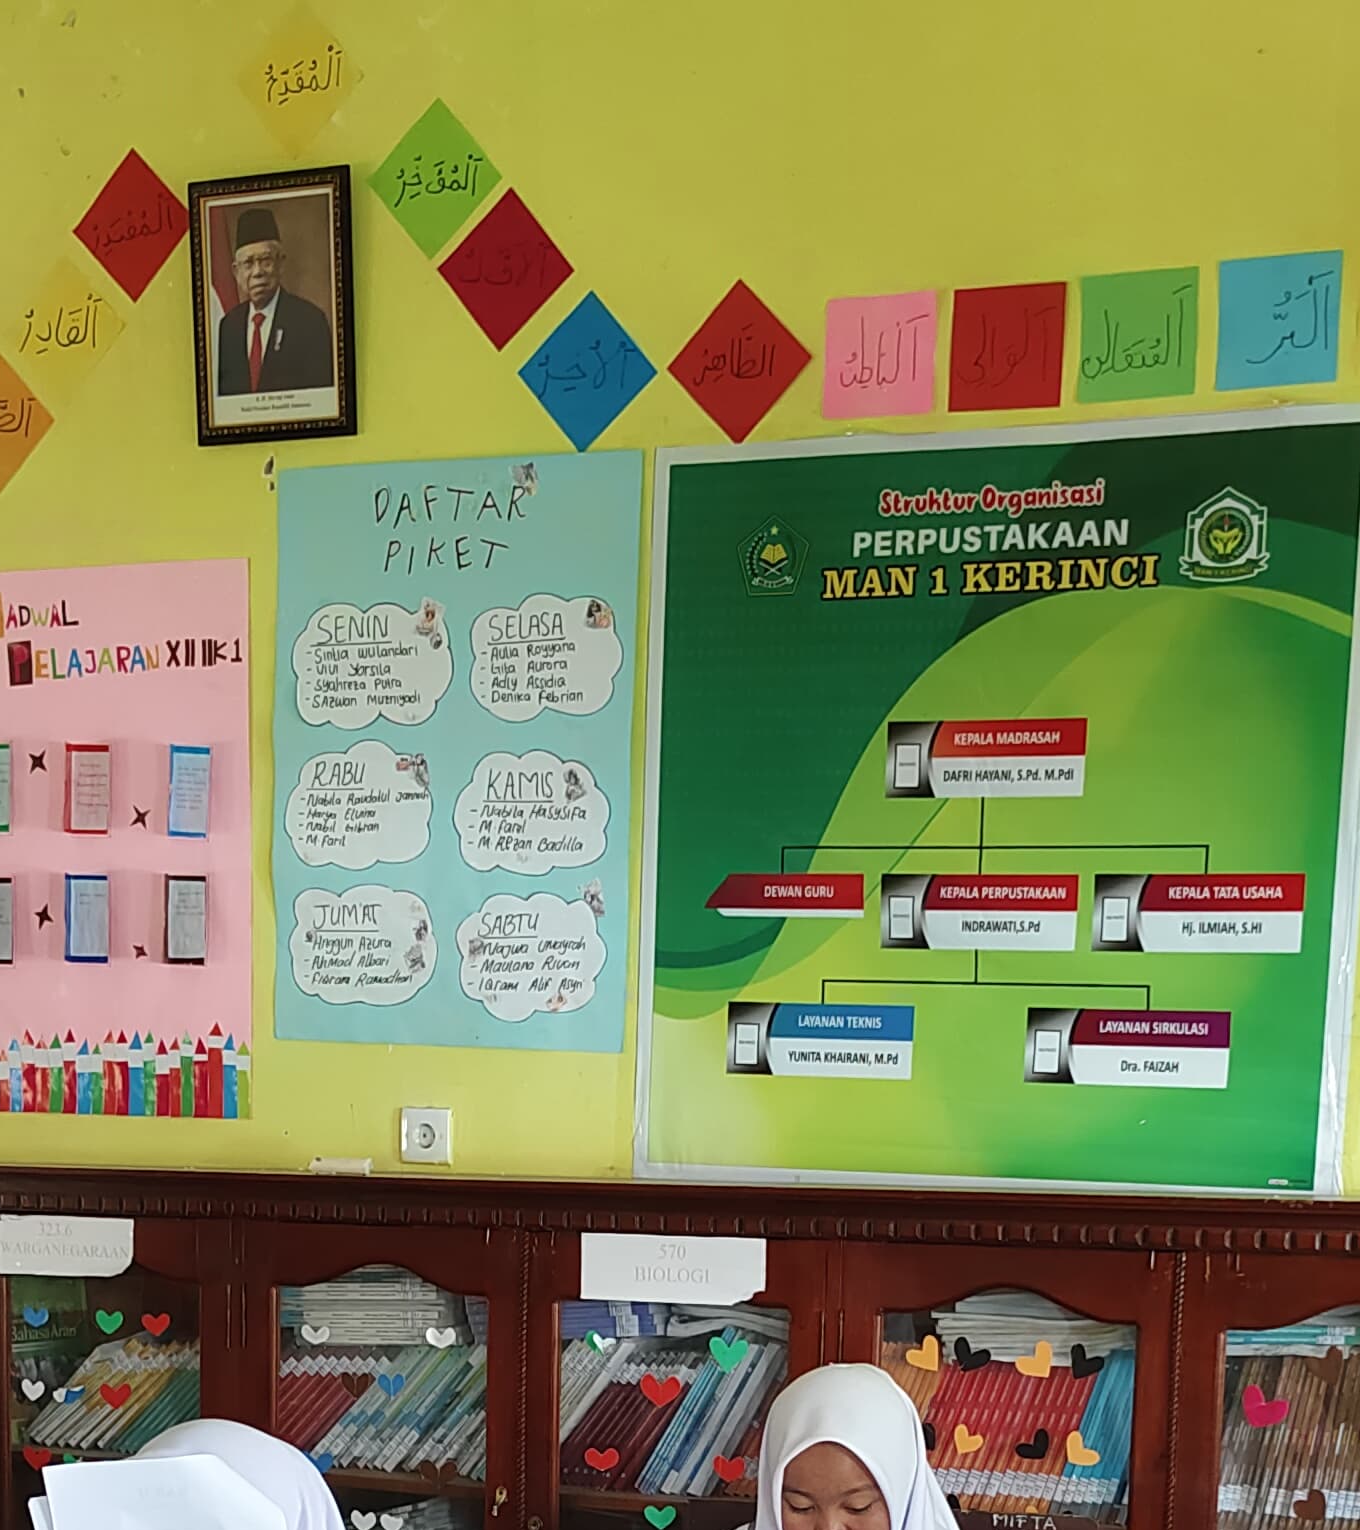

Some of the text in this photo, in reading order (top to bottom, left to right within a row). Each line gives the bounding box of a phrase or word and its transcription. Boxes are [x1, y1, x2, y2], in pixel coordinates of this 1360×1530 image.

[375, 485, 526, 529] DAFTAR
[878, 478, 1106, 517] Struktur Organisasi
[852, 517, 1129, 558] PERPUSTAKAAN
[384, 536, 510, 575] PIKET
[822, 555, 1160, 599] MAN 1 KERINCI
[317, 615, 389, 645] SENIN
[489, 612, 564, 642] SELASA
[10, 643, 160, 683] PELAJARAN
[953, 730, 1060, 746] KEPALA MADRASAH
[311, 760, 365, 787] RABU
[487, 768, 554, 800] KAMIS
[943, 769, 973, 784] DAFRI
[763, 885, 834, 899] DEWAN GURU
[940, 885, 1067, 900] KEPALA PERPUSTAKAAN
[1168, 885, 1283, 900] KEPALA TATA USAHA
[478, 912, 539, 937] SABTU
[798, 1015, 882, 1030] LAYANAN TEKNIS
[1099, 1020, 1209, 1037] LAYANAN SIRKULASI
[788, 1051, 821, 1065] YUNITA
[1143, 1060, 1180, 1074] FAIZAH
[657, 1244, 686, 1260] 570
[634, 1266, 711, 1284] BIOLOGI
